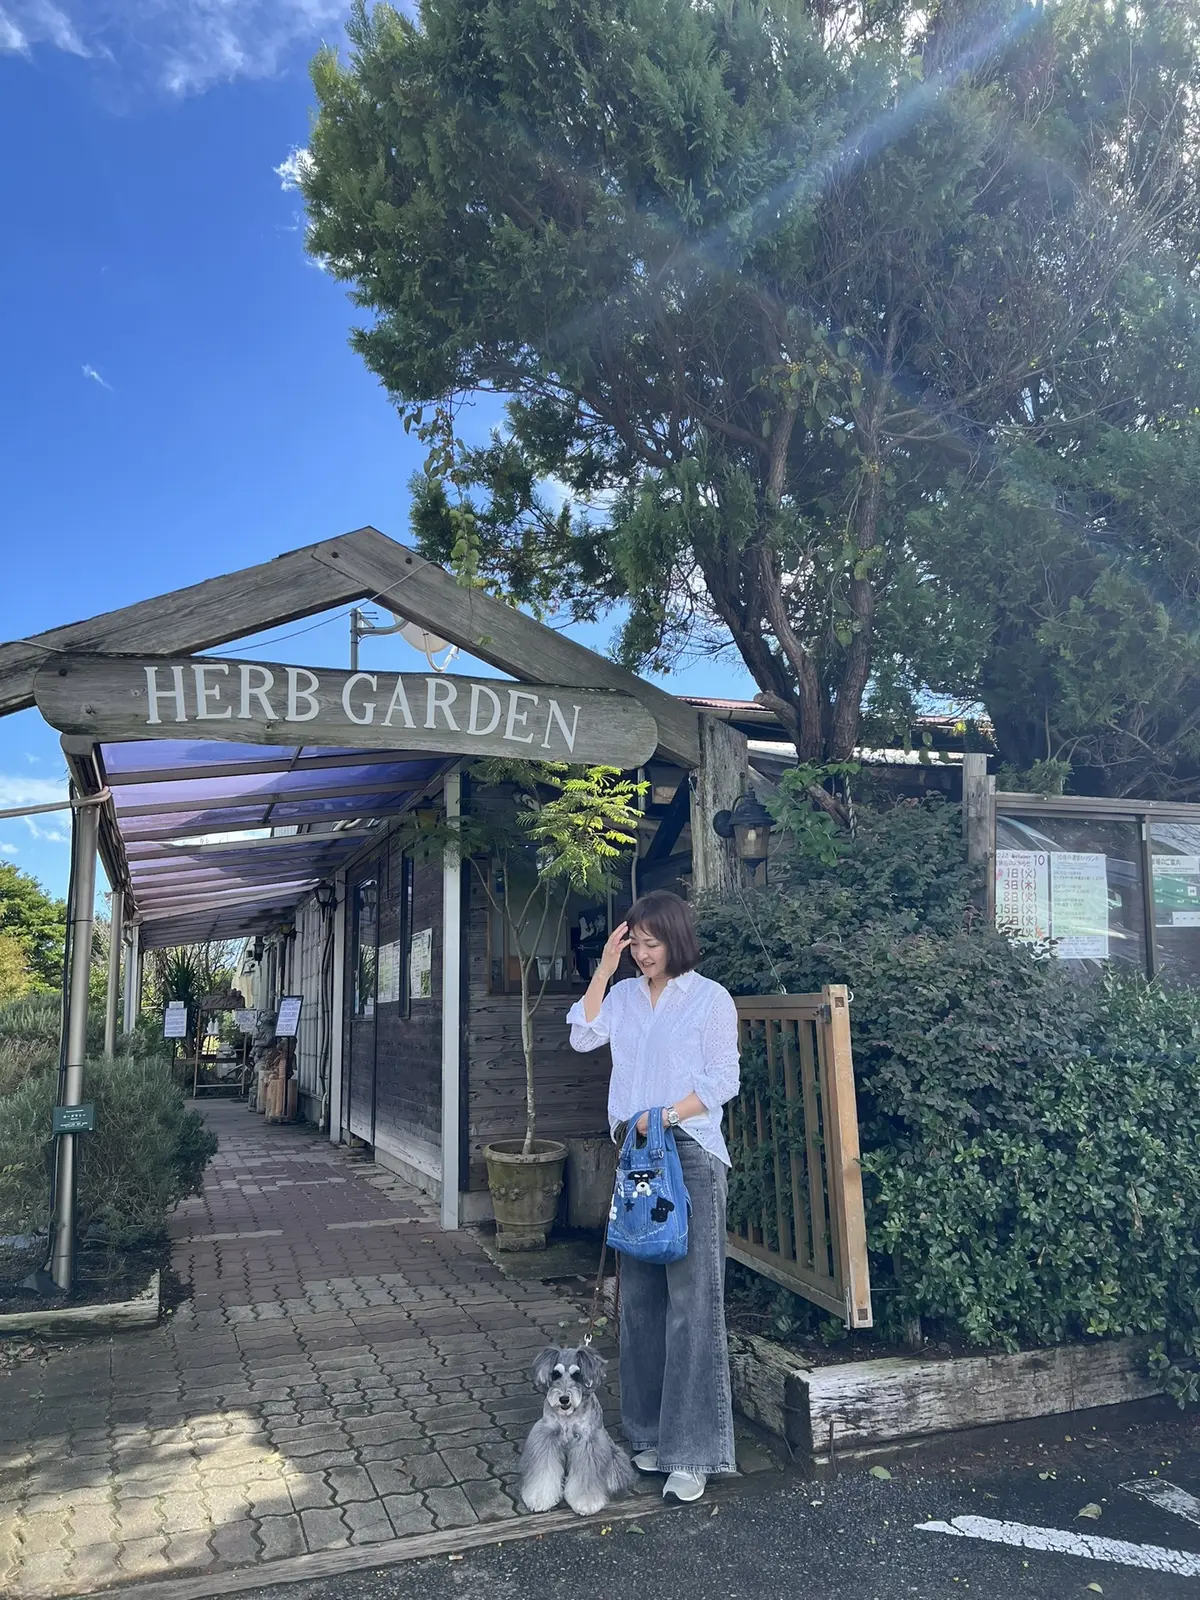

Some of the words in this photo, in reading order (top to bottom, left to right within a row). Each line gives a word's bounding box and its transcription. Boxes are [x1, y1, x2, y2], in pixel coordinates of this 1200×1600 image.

[143, 664, 320, 724] HERB
[341, 672, 582, 754] GARDEN
[1033, 854, 1046, 866] 10
